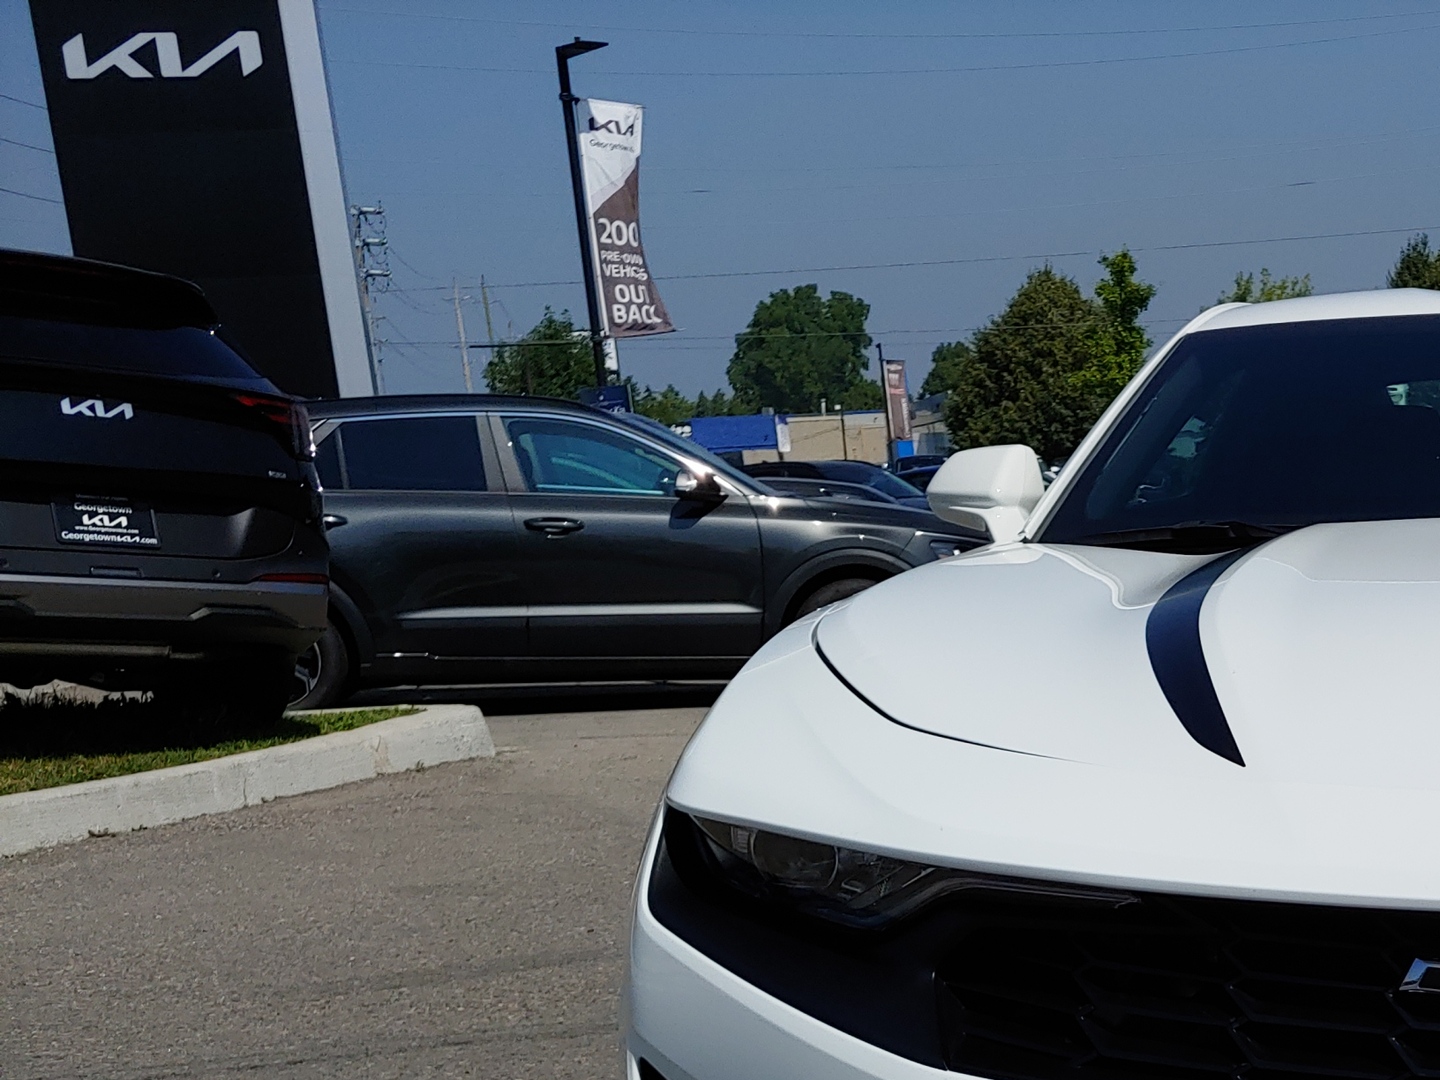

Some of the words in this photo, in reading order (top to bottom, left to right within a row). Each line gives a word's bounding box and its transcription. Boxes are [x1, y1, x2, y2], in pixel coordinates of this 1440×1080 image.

[62, 30, 263, 79] KIA
[598, 217, 639, 248] 200
[60, 397, 134, 420] KIA
[74, 502, 132, 514] Georgetown
[82, 513, 128, 528] KIA
